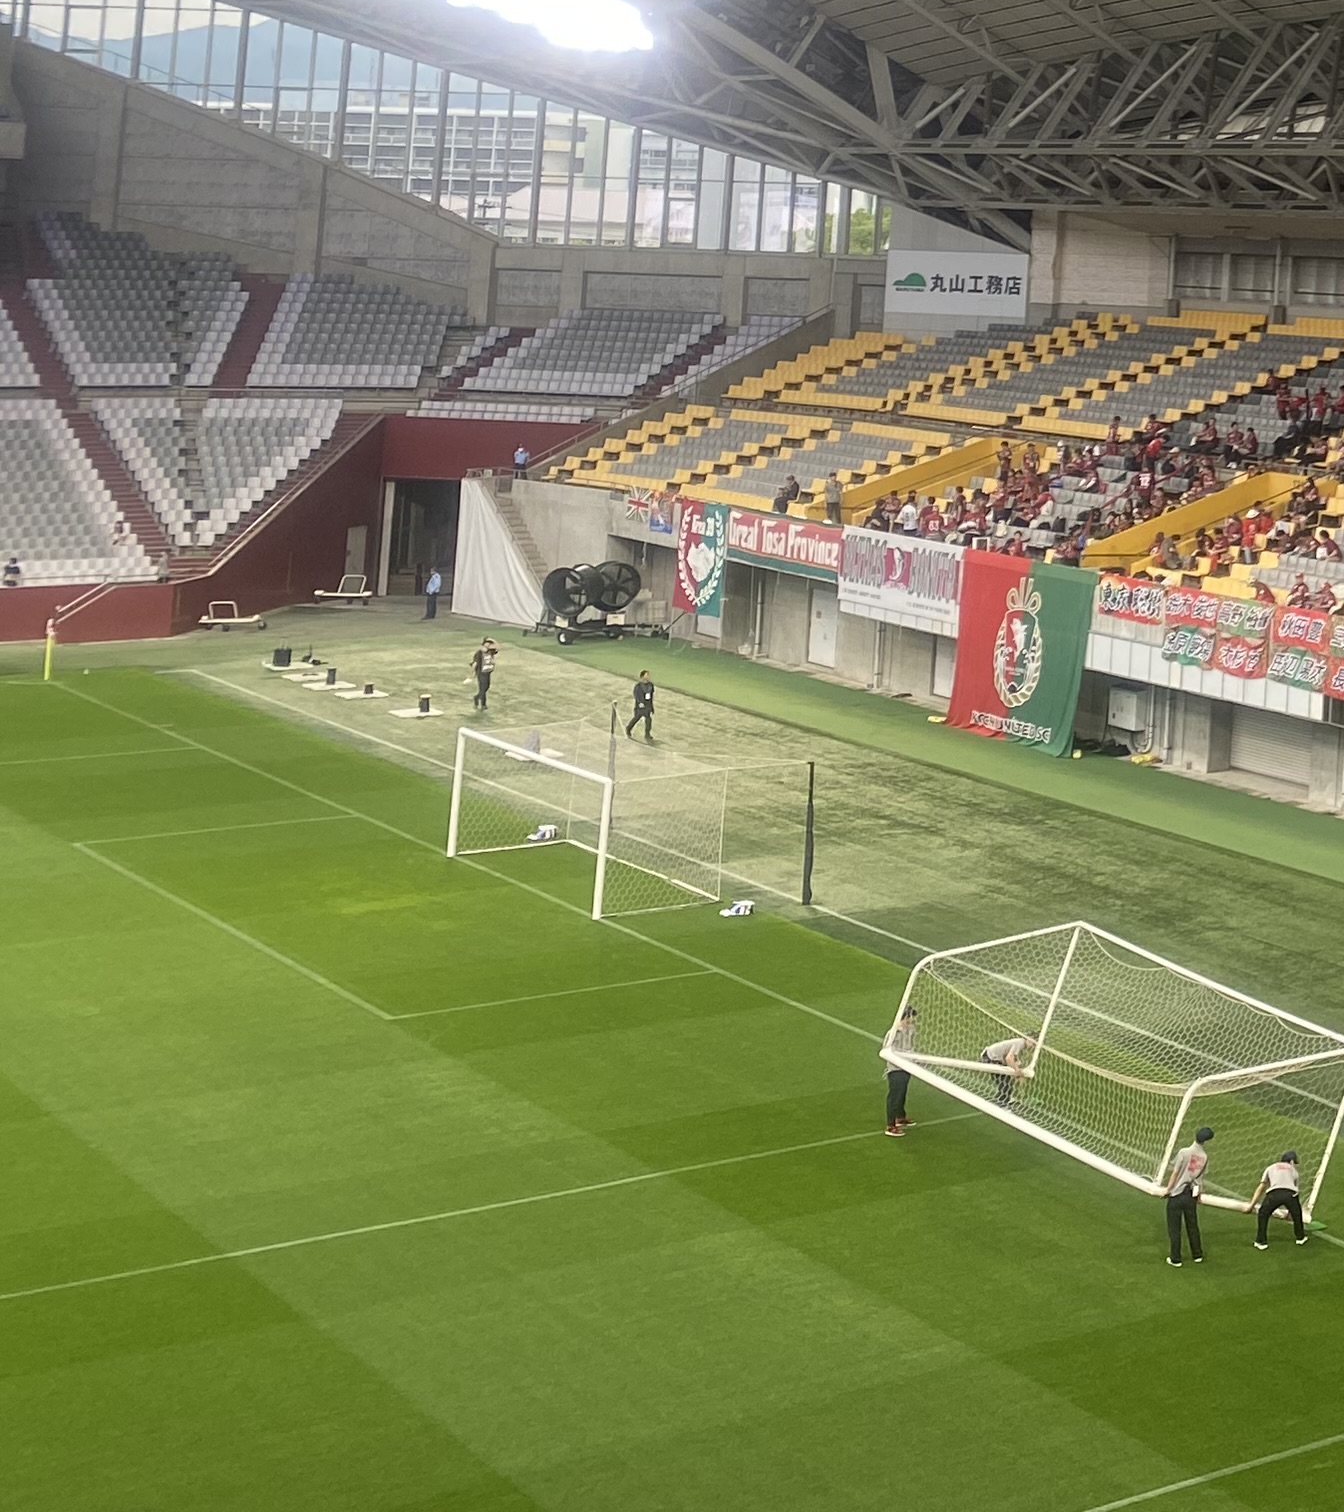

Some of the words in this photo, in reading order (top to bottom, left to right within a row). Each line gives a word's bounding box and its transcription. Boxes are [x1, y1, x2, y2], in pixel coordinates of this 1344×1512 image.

[929, 273, 1023, 296] 丸山工務店
[786, 523, 840, 568] Province
